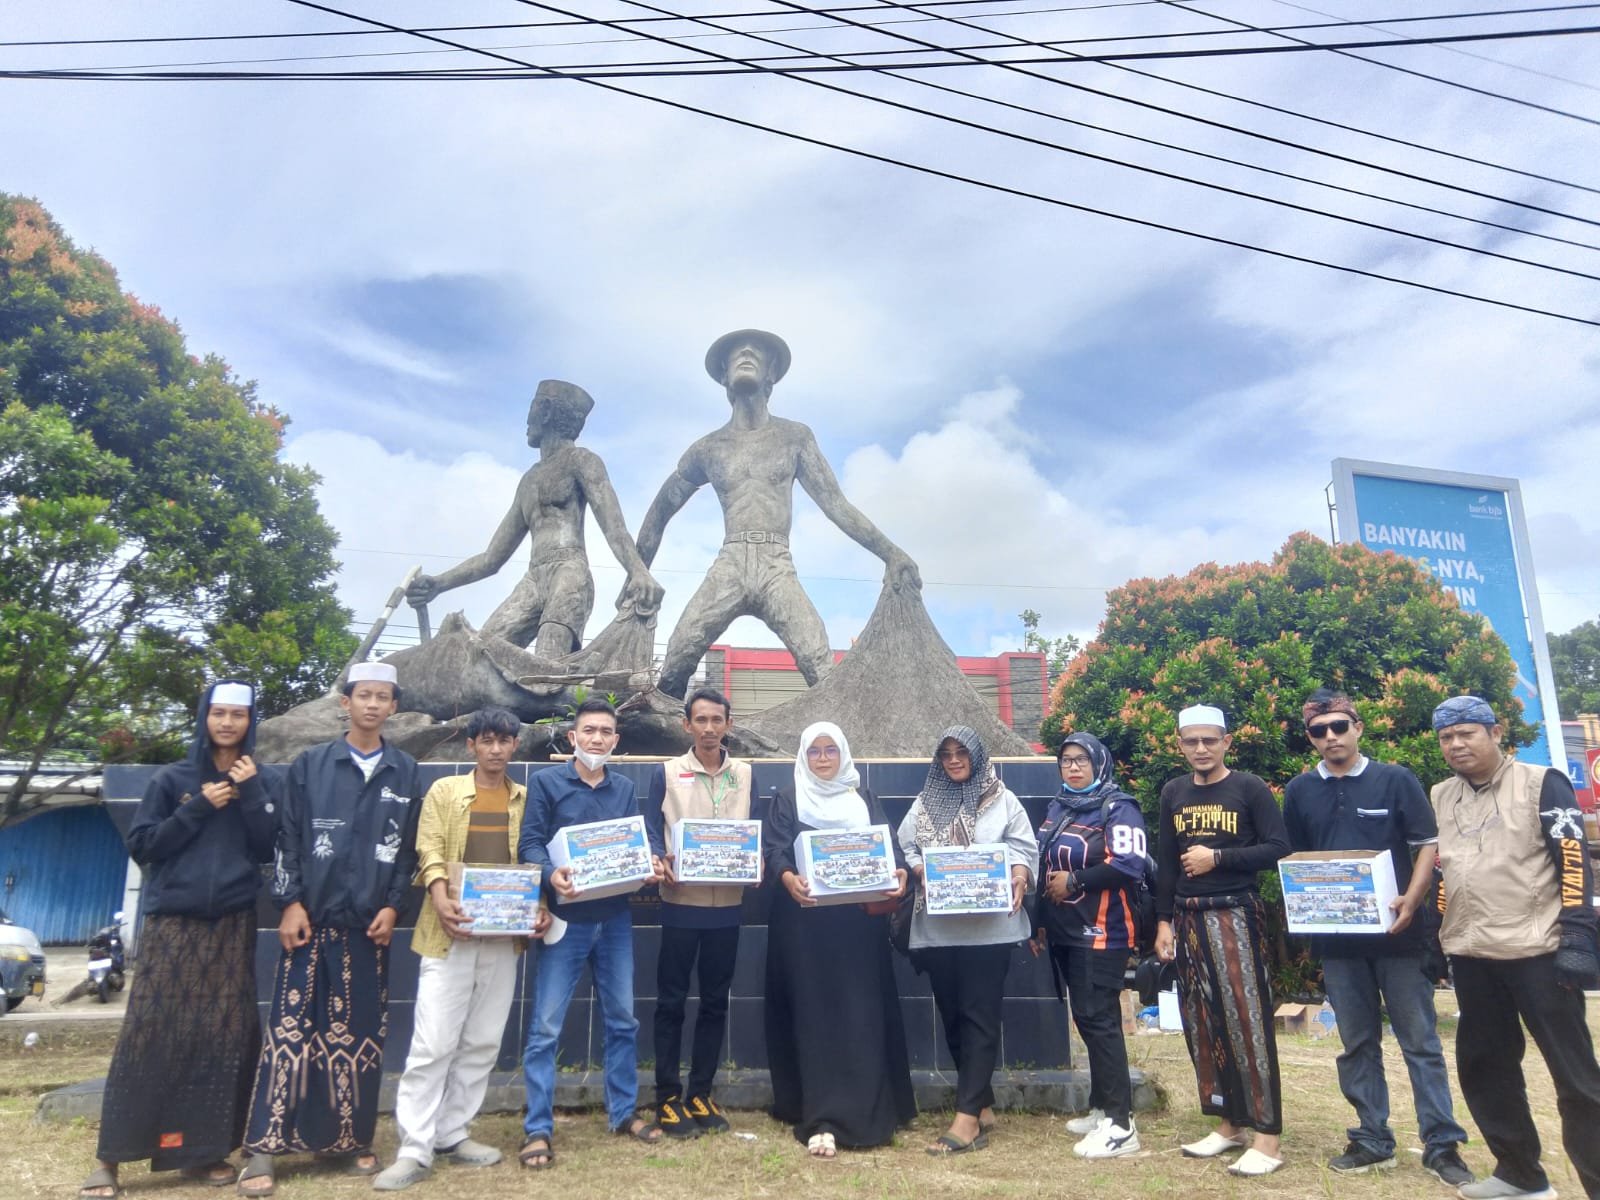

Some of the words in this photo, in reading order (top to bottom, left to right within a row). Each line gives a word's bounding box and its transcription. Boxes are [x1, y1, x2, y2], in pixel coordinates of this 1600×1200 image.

[1364, 522, 1466, 552] BANYAKIN
[1182, 804, 1223, 814] MUHAMMAD
[1111, 824, 1147, 859] 80
